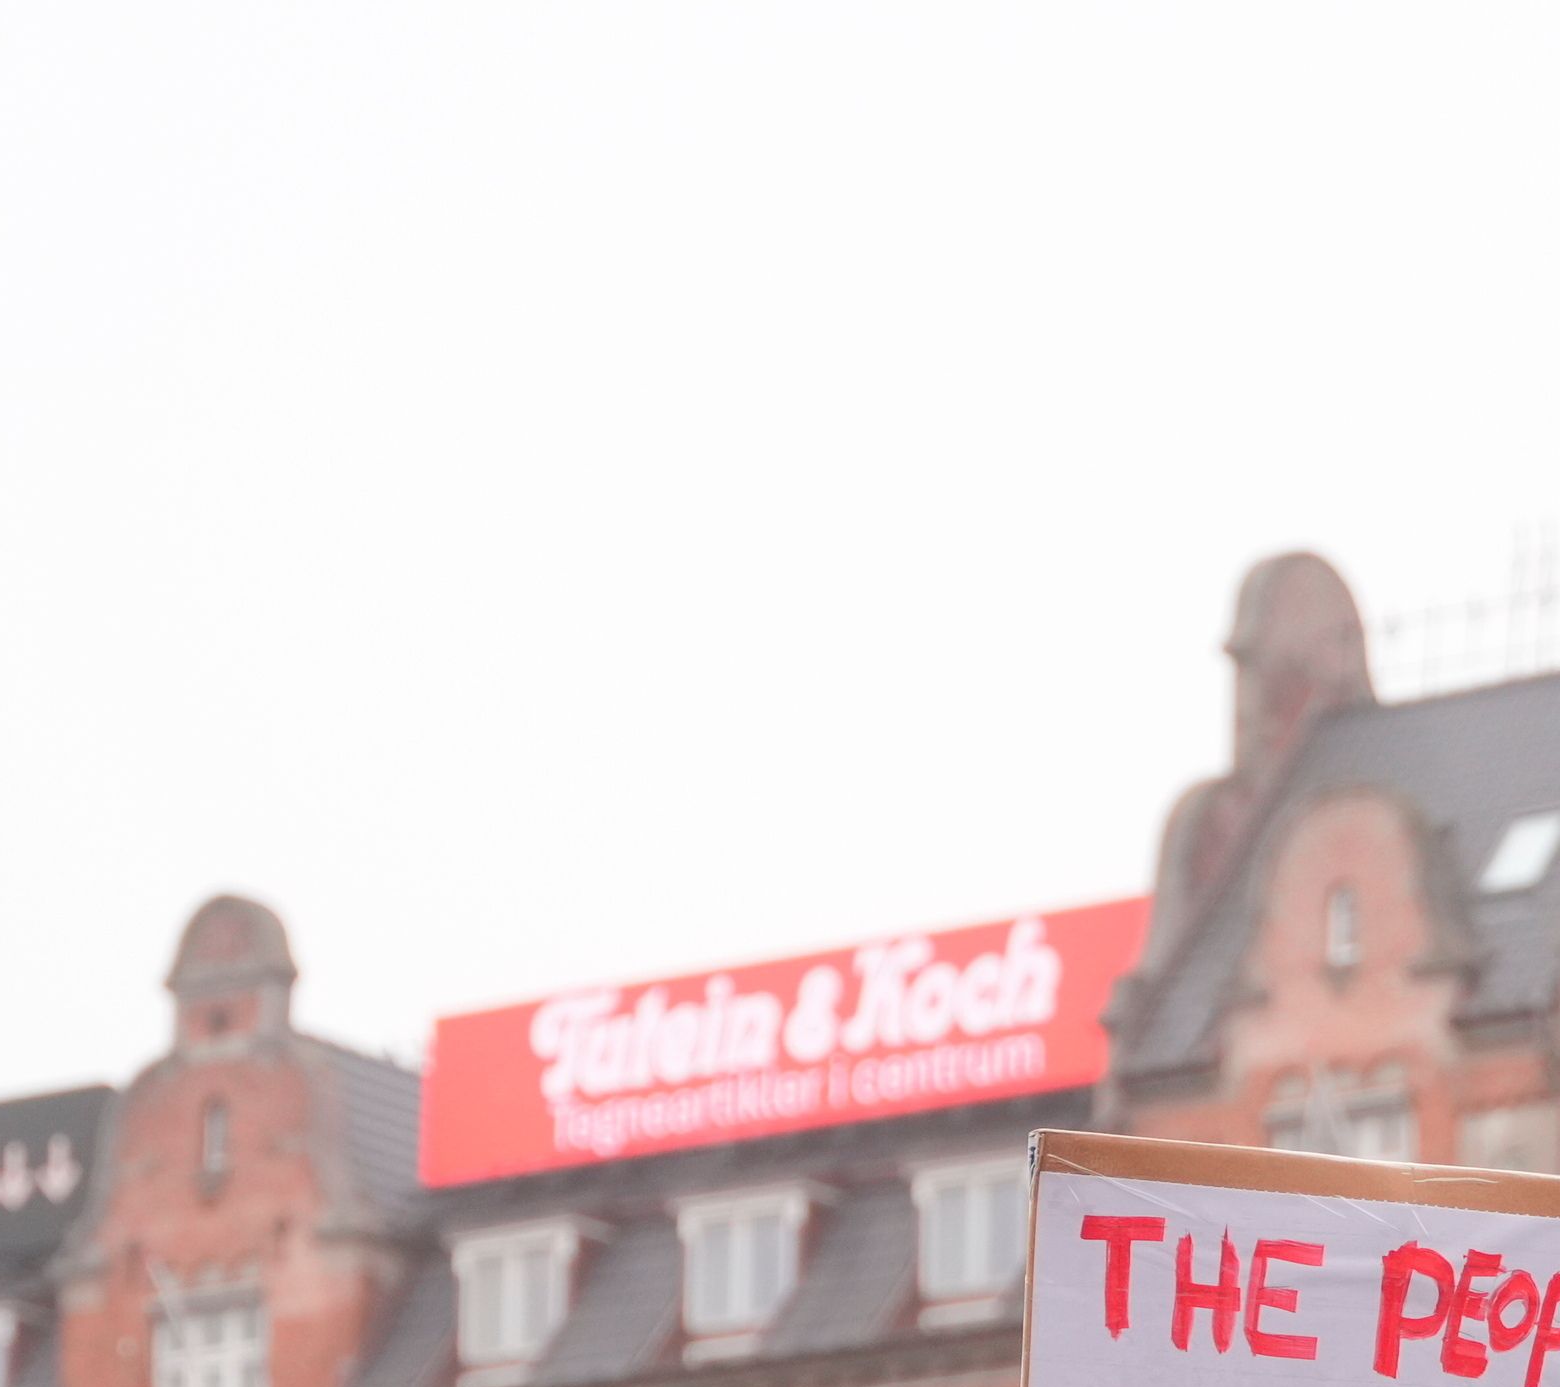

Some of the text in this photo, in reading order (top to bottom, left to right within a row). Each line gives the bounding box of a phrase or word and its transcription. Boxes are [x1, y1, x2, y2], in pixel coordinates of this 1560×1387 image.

[841, 916, 1063, 1053] Koch
[849, 1033, 1047, 1105] centrum
[1078, 1214, 1326, 1361] THE
